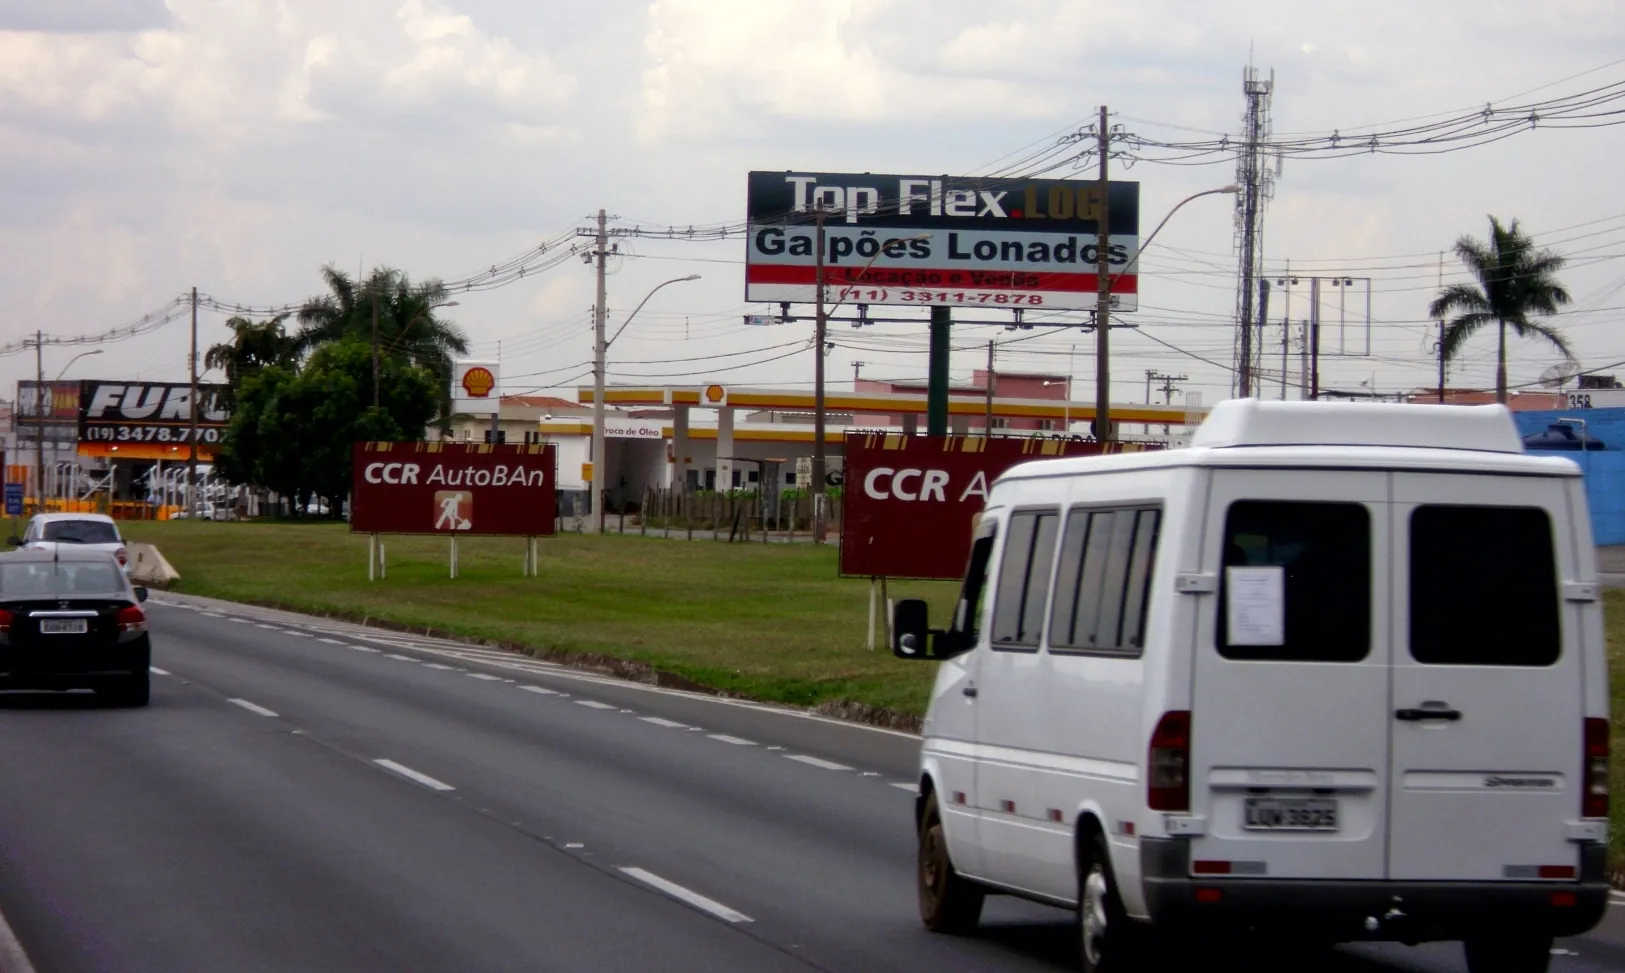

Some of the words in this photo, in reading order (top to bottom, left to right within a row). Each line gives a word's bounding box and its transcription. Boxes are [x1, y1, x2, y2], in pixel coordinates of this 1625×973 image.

[785, 176, 878, 224] Top
[947, 233, 1129, 265] Lonados
[840, 289, 888, 302] (11)
[901, 291, 1044, 306] 3311-7878
[87, 426, 115, 441] (19)
[604, 427, 624, 435] roca
[626, 427, 637, 435] de
[364, 462, 420, 485] CCR
[426, 464, 545, 487] AutoBAn
[864, 467, 950, 502] CCR
